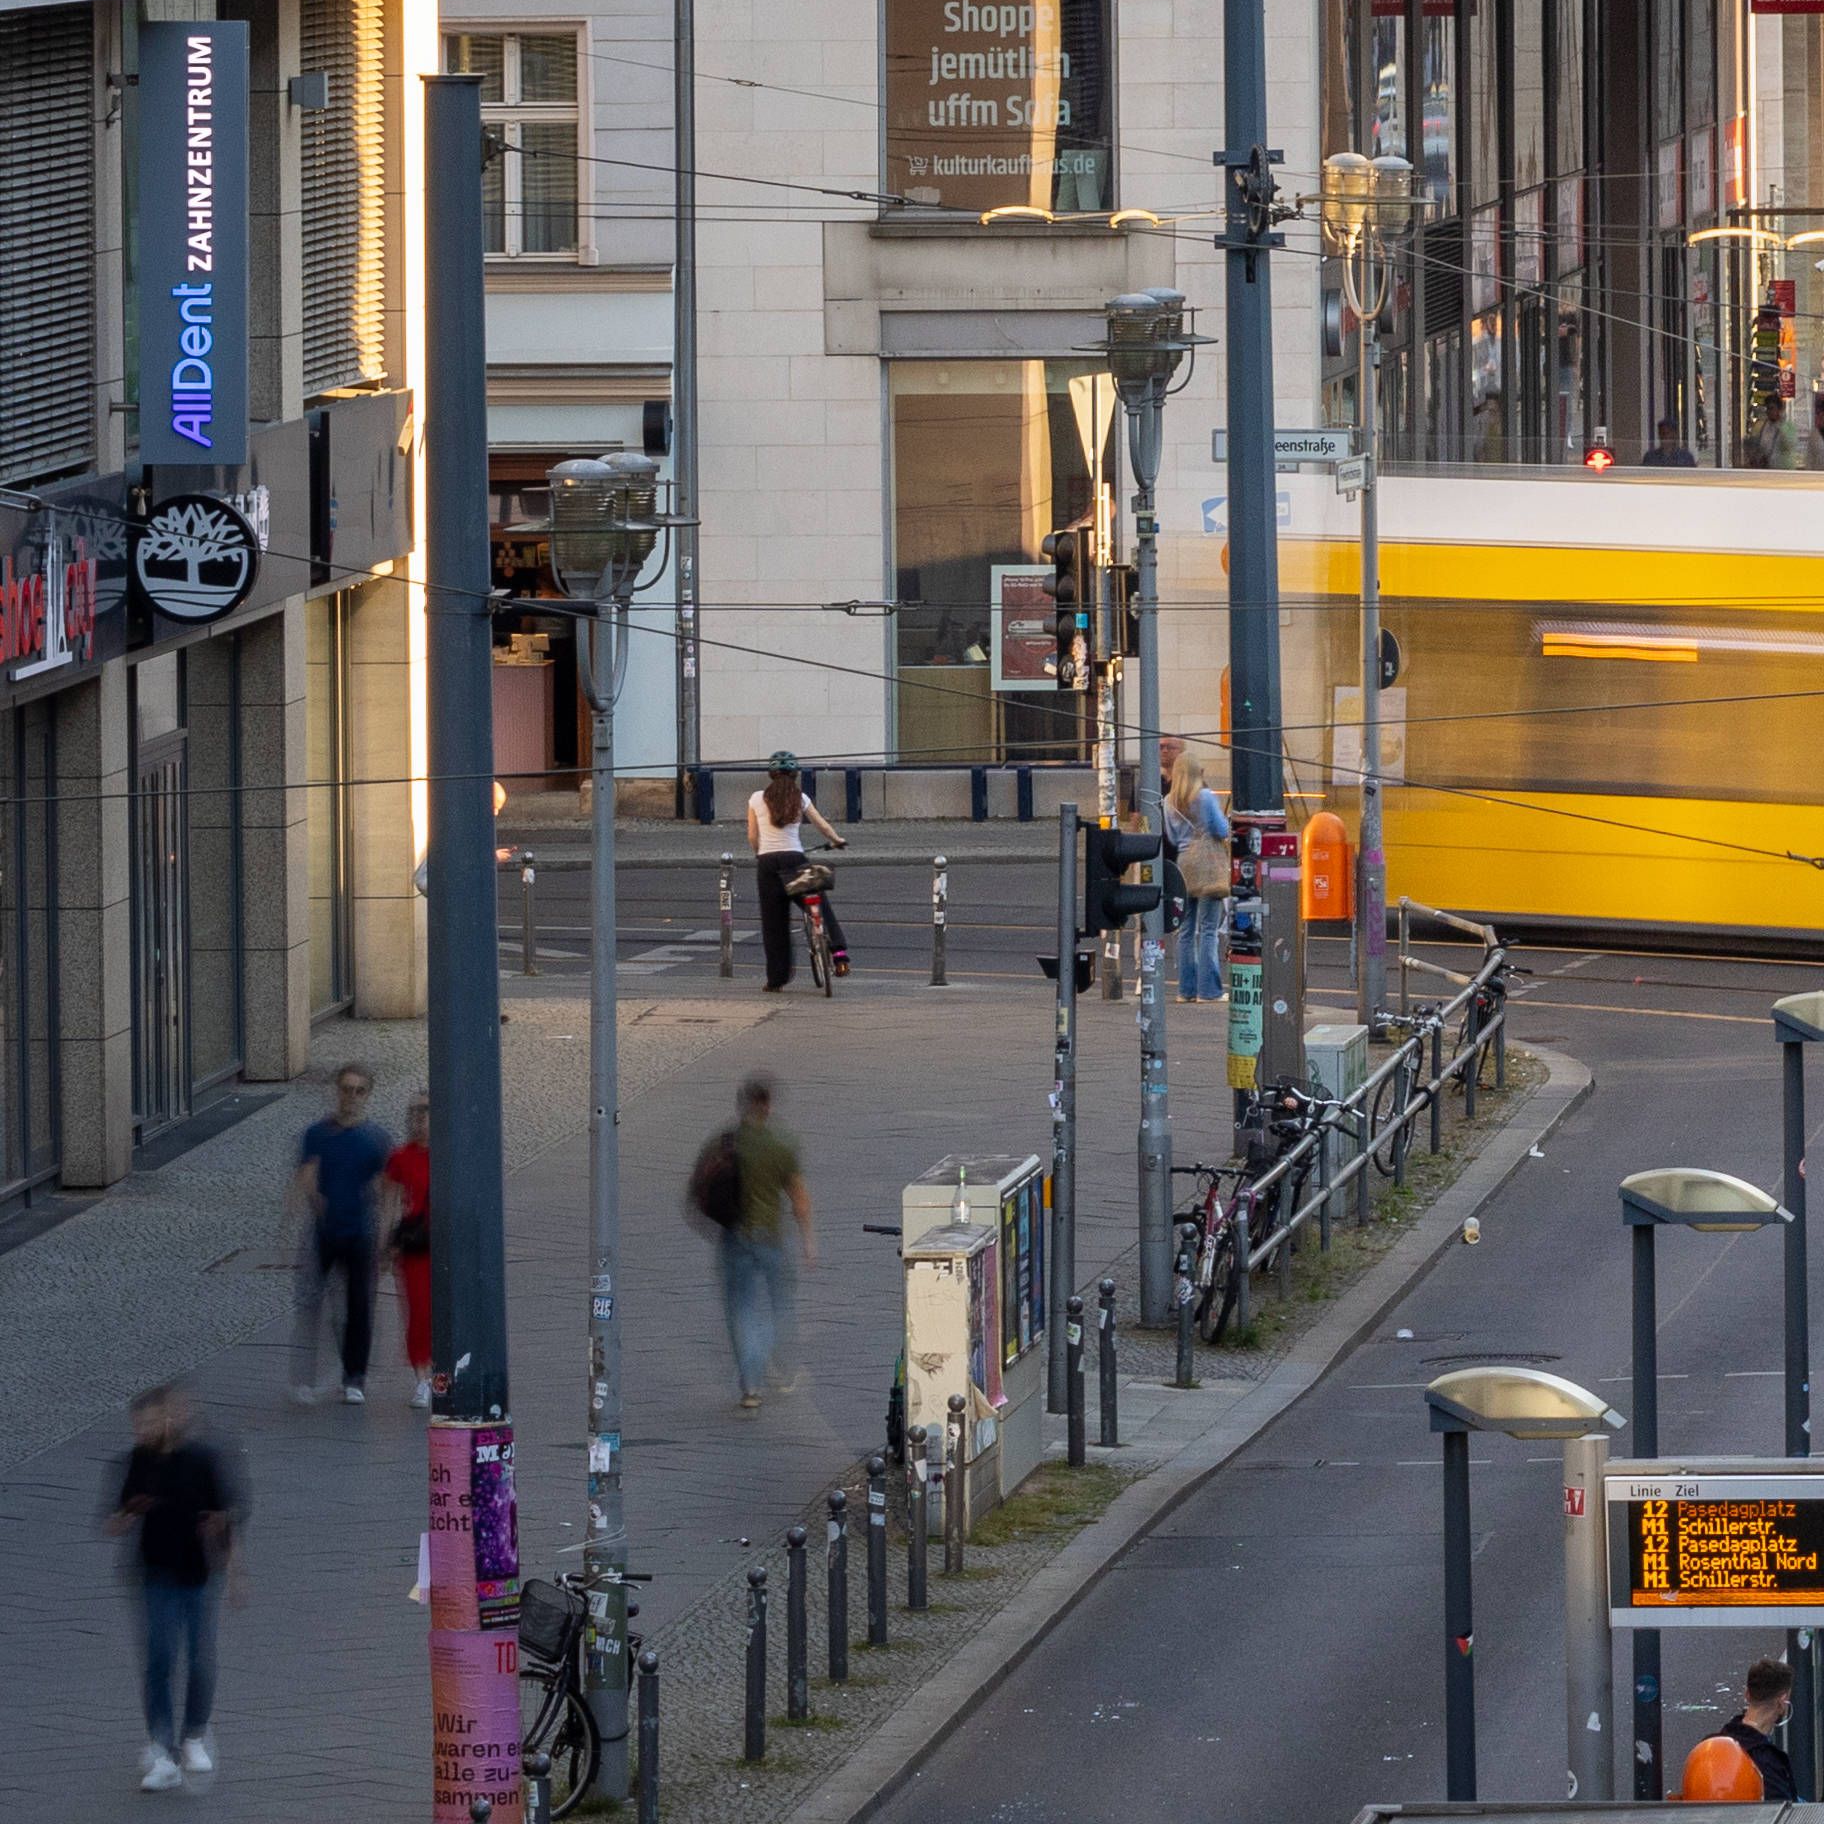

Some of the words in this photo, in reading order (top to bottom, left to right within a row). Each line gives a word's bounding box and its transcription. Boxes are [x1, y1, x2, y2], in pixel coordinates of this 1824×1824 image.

[944, 1, 1053, 37] Shoppe
[930, 46, 1070, 85] jemütlich
[929, 94, 998, 126] uffm
[1007, 95, 1071, 126] Sofa
[186, 37, 213, 272] ZAHNZENTRUM
[934, 154, 1095, 177] kulturkaufus.de
[171, 282, 213, 449] AllDent
[1630, 1484, 1661, 1497] Linie
[1675, 1483, 1699, 1497] Ziel
[1643, 1501, 1668, 1517] 12
[1678, 1501, 1797, 1520] Pasedagplatz
[1642, 1519, 1668, 1535] M1
[1678, 1518, 1777, 1535] Schillerstr.
[1643, 1537, 1668, 1553] 12
[1678, 1535, 1797, 1555] Pasedagplatz
[1643, 1554, 1669, 1571] M1
[1679, 1553, 1768, 1571] Rosenthal
[1777, 1553, 1817, 1570] Nord
[1643, 1572, 1669, 1588] M1
[1679, 1571, 1778, 1588] Schillerstr.
[433, 1742, 500, 1757] waren
